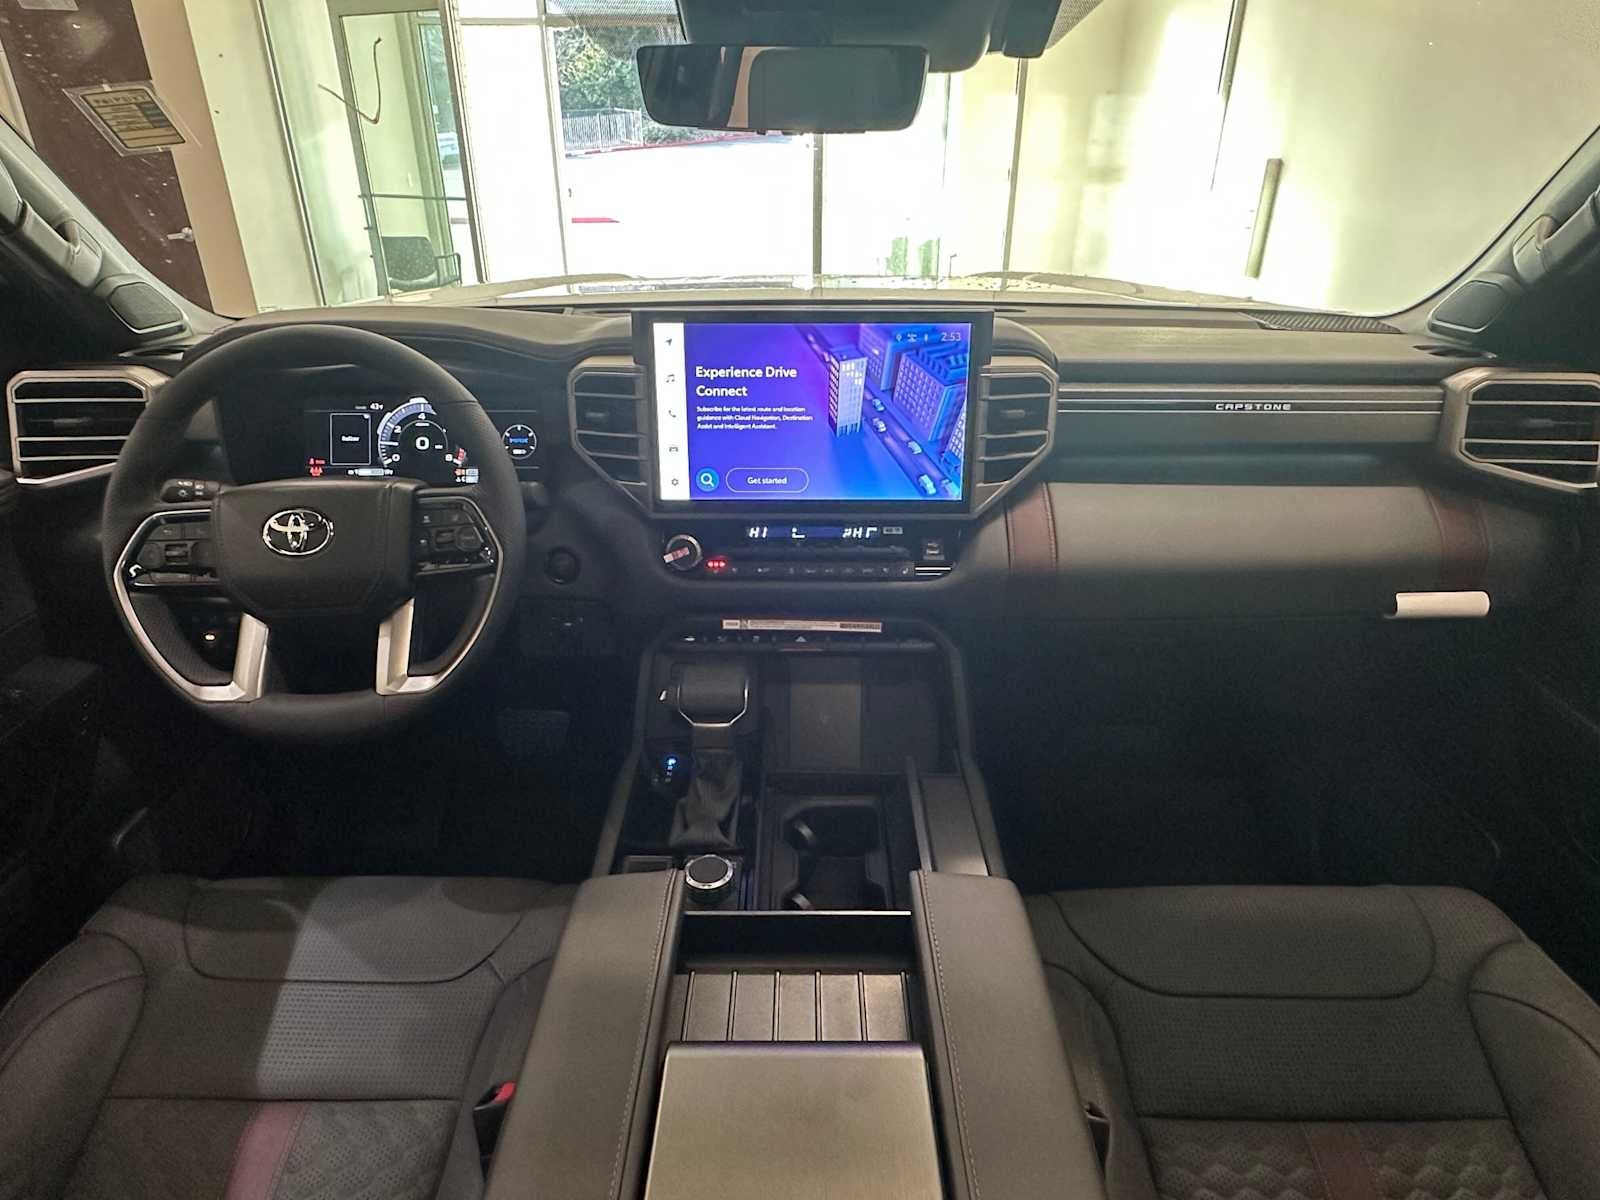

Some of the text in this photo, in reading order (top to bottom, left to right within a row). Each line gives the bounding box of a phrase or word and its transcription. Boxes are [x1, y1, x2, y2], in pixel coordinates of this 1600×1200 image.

[941, 332, 961, 342] 2:53
[695, 366, 798, 380] Experience Drive
[695, 385, 748, 397] Connect
[1215, 403, 1292, 411] CAPSTONE
[415, 436, 430, 451] 0
[747, 476, 788, 485] Get started
[749, 526, 768, 538] HI
